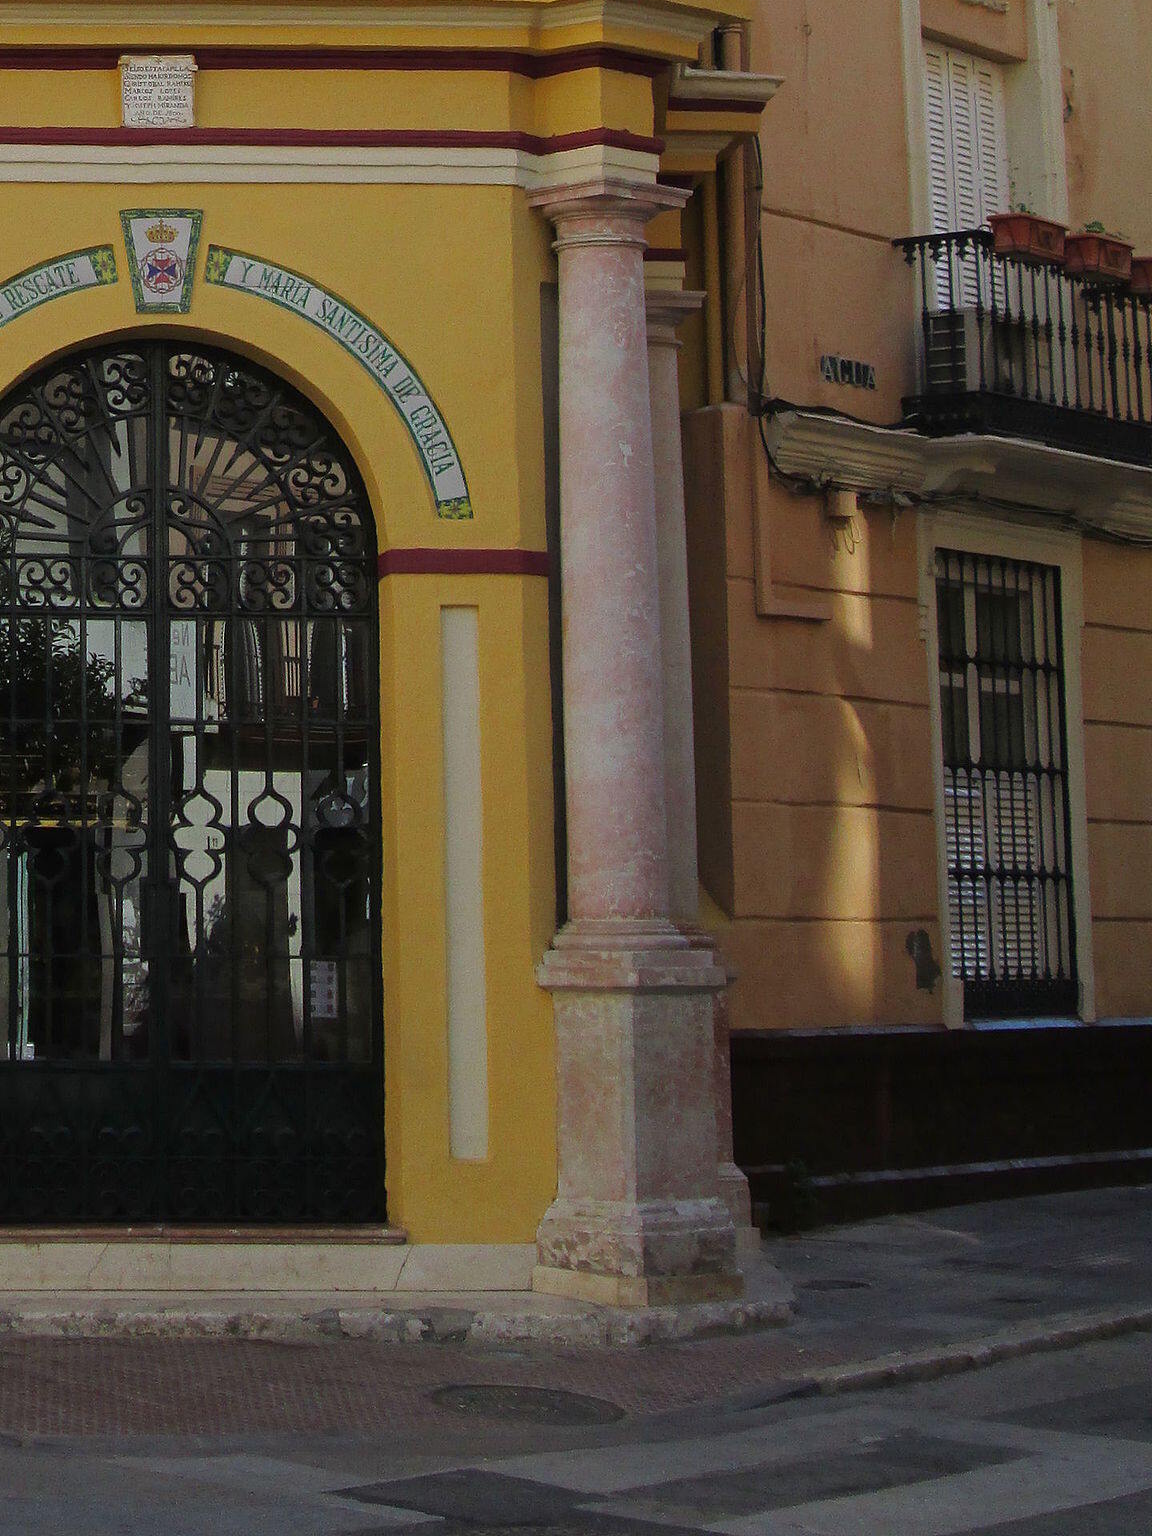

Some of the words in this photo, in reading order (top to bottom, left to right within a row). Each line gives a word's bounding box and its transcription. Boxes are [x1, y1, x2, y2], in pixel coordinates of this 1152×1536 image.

[1, 263, 80, 311] RESCATE
[241, 261, 255, 283] Y
[316, 298, 399, 377] SANTISIMA
[393, 375, 422, 404] DE
[410, 405, 455, 475] GRACIA
